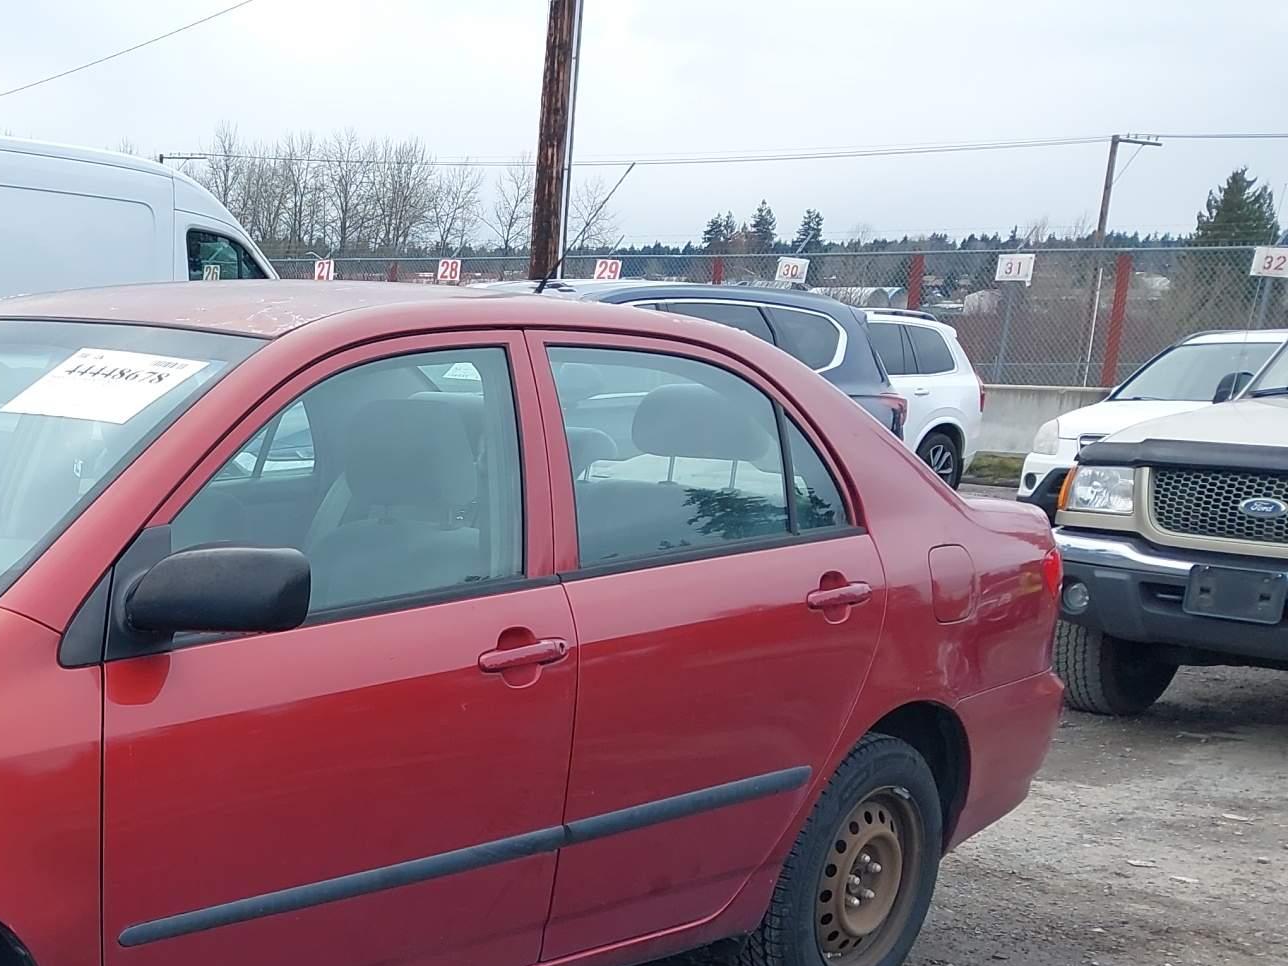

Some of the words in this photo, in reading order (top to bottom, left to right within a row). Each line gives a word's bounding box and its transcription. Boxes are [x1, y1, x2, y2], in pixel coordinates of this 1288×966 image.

[316, 261, 331, 280] 27
[439, 260, 459, 279] 28
[596, 260, 620, 280] 29
[782, 263, 799, 277] 30
[1004, 261, 1023, 275] 31
[1263, 255, 1287, 271] 32
[205, 265, 219, 280] 26
[64, 364, 170, 384] 44448678
[1249, 501, 1274, 513] Ford
